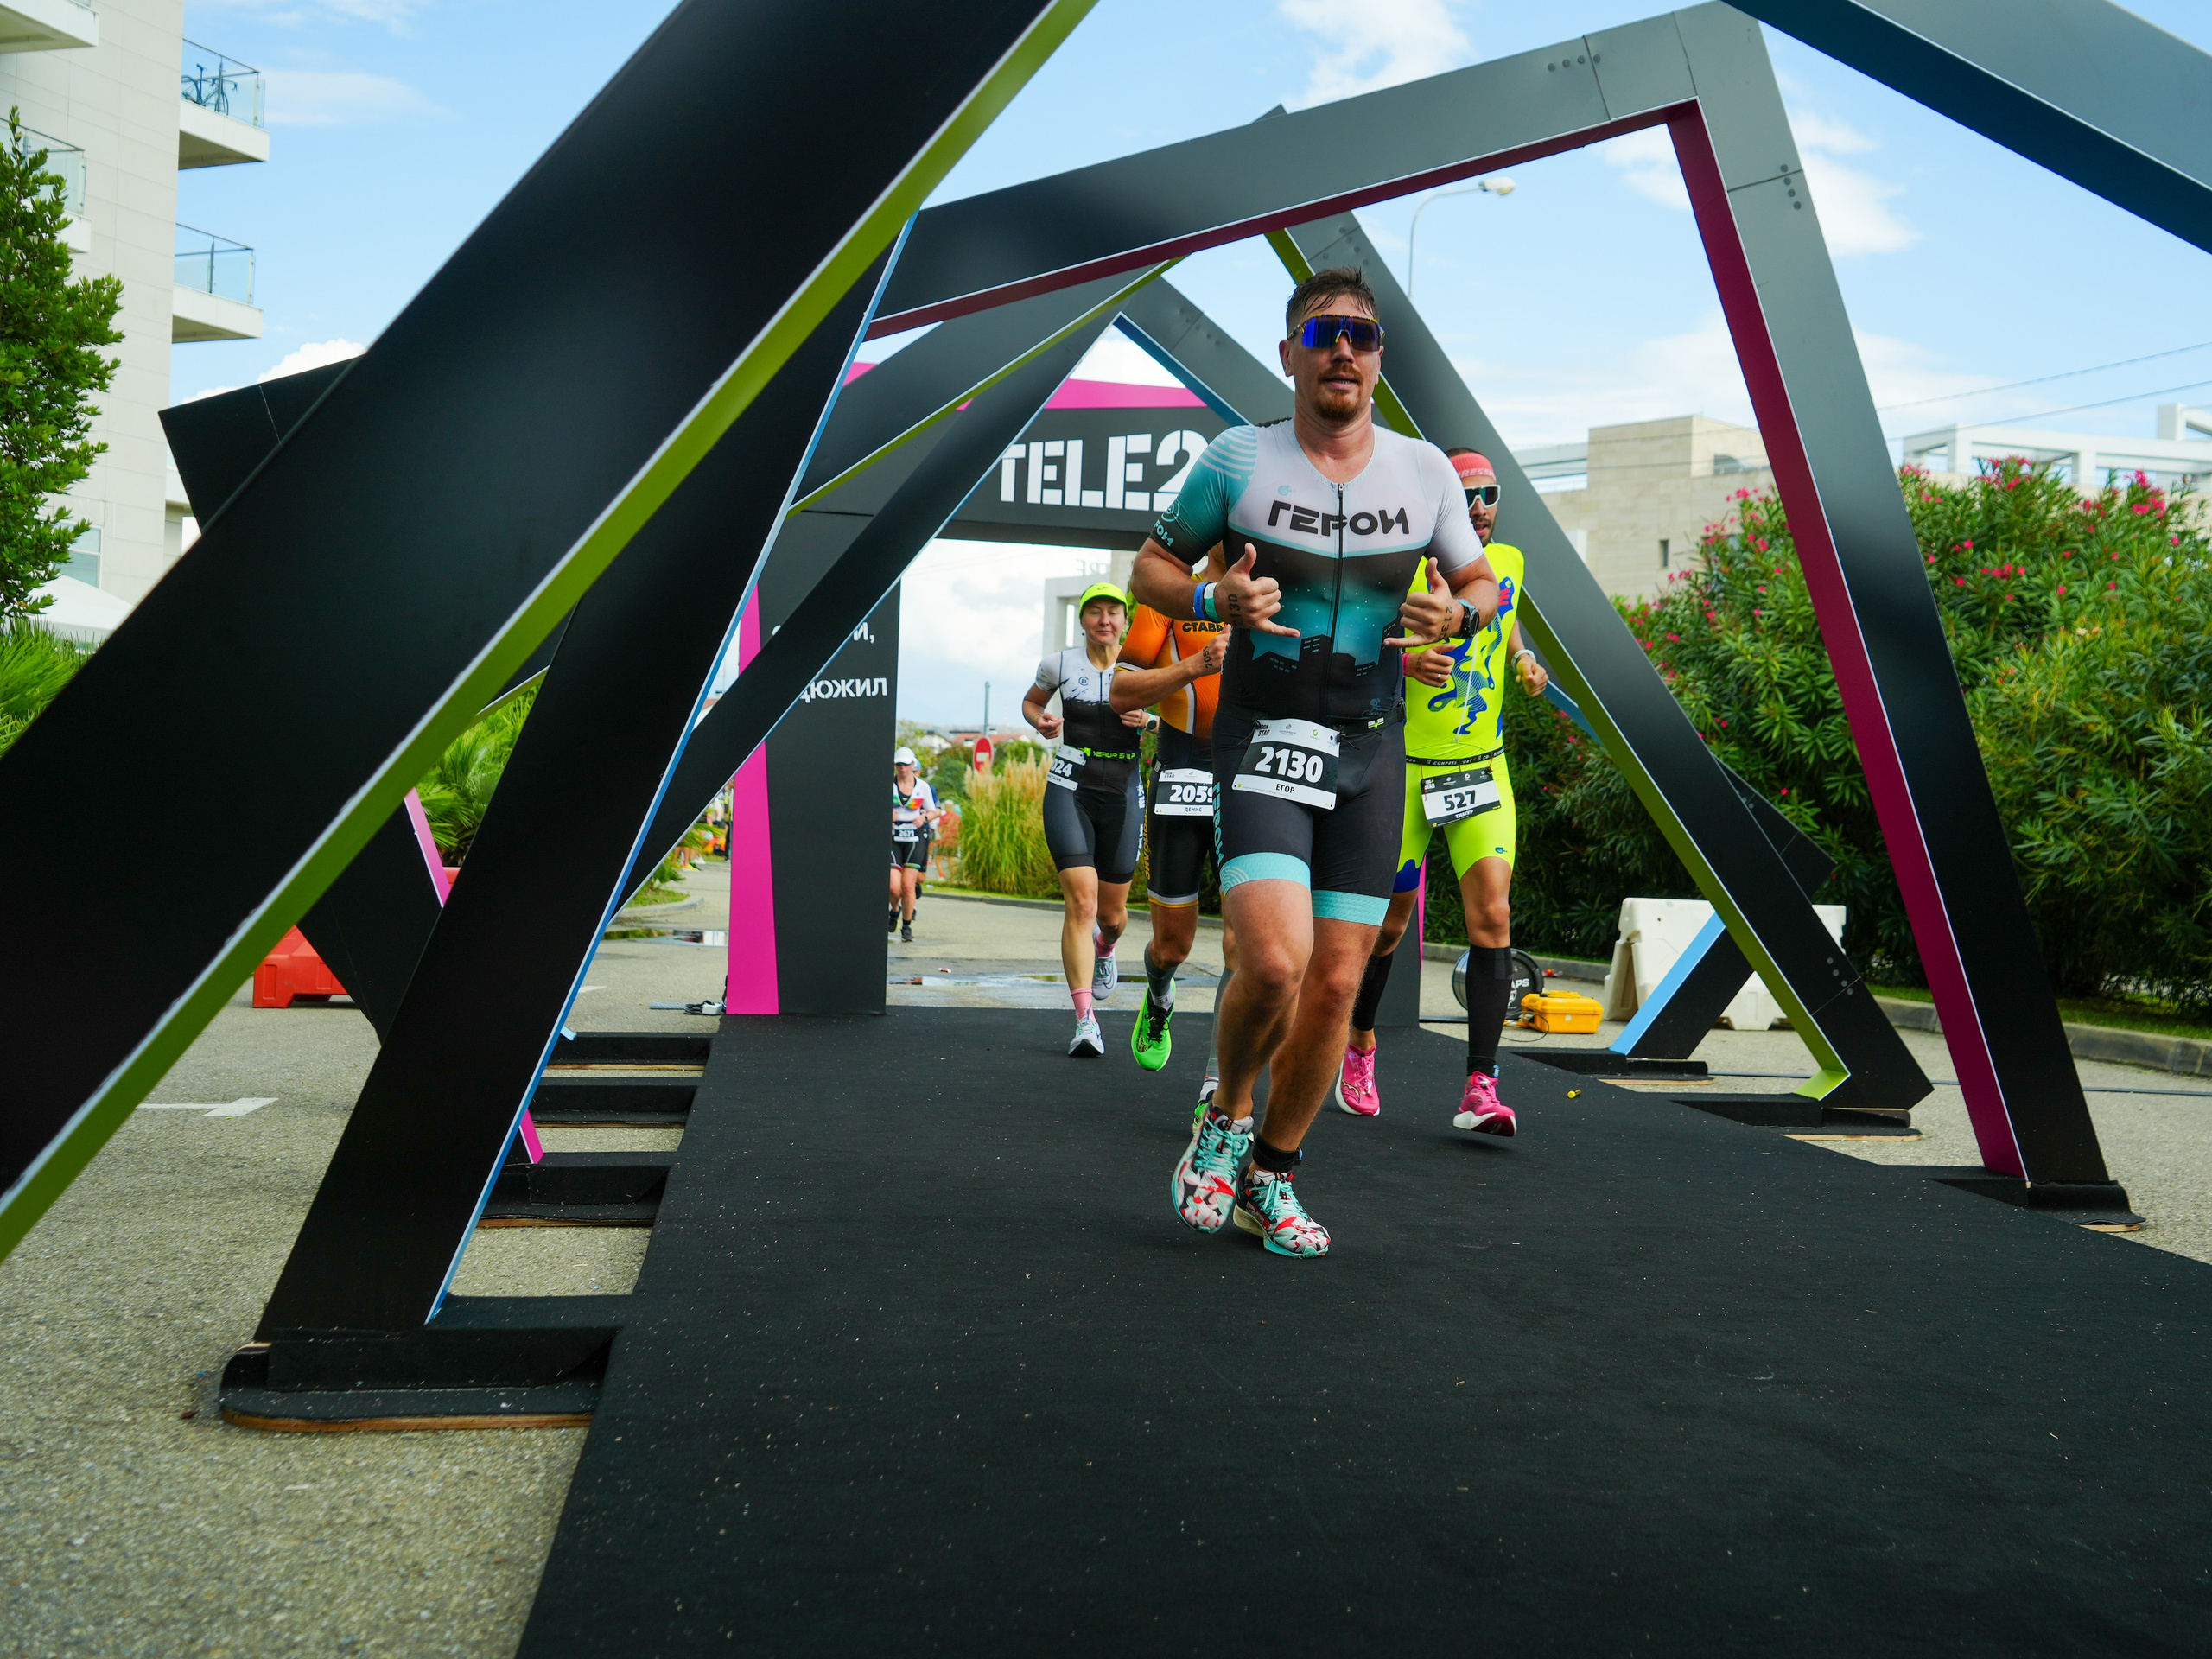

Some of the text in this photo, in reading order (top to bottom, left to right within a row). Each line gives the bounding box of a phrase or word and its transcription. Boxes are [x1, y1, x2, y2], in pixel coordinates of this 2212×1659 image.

[1001, 429, 1209, 512] TELE2
[1268, 500, 1410, 536] ГЕРОИ
[1182, 622, 1225, 632] СТАВР
[1255, 746, 1324, 784] 2130
[1275, 784, 1295, 793] ЕГОР
[1444, 790, 1476, 812] 527
